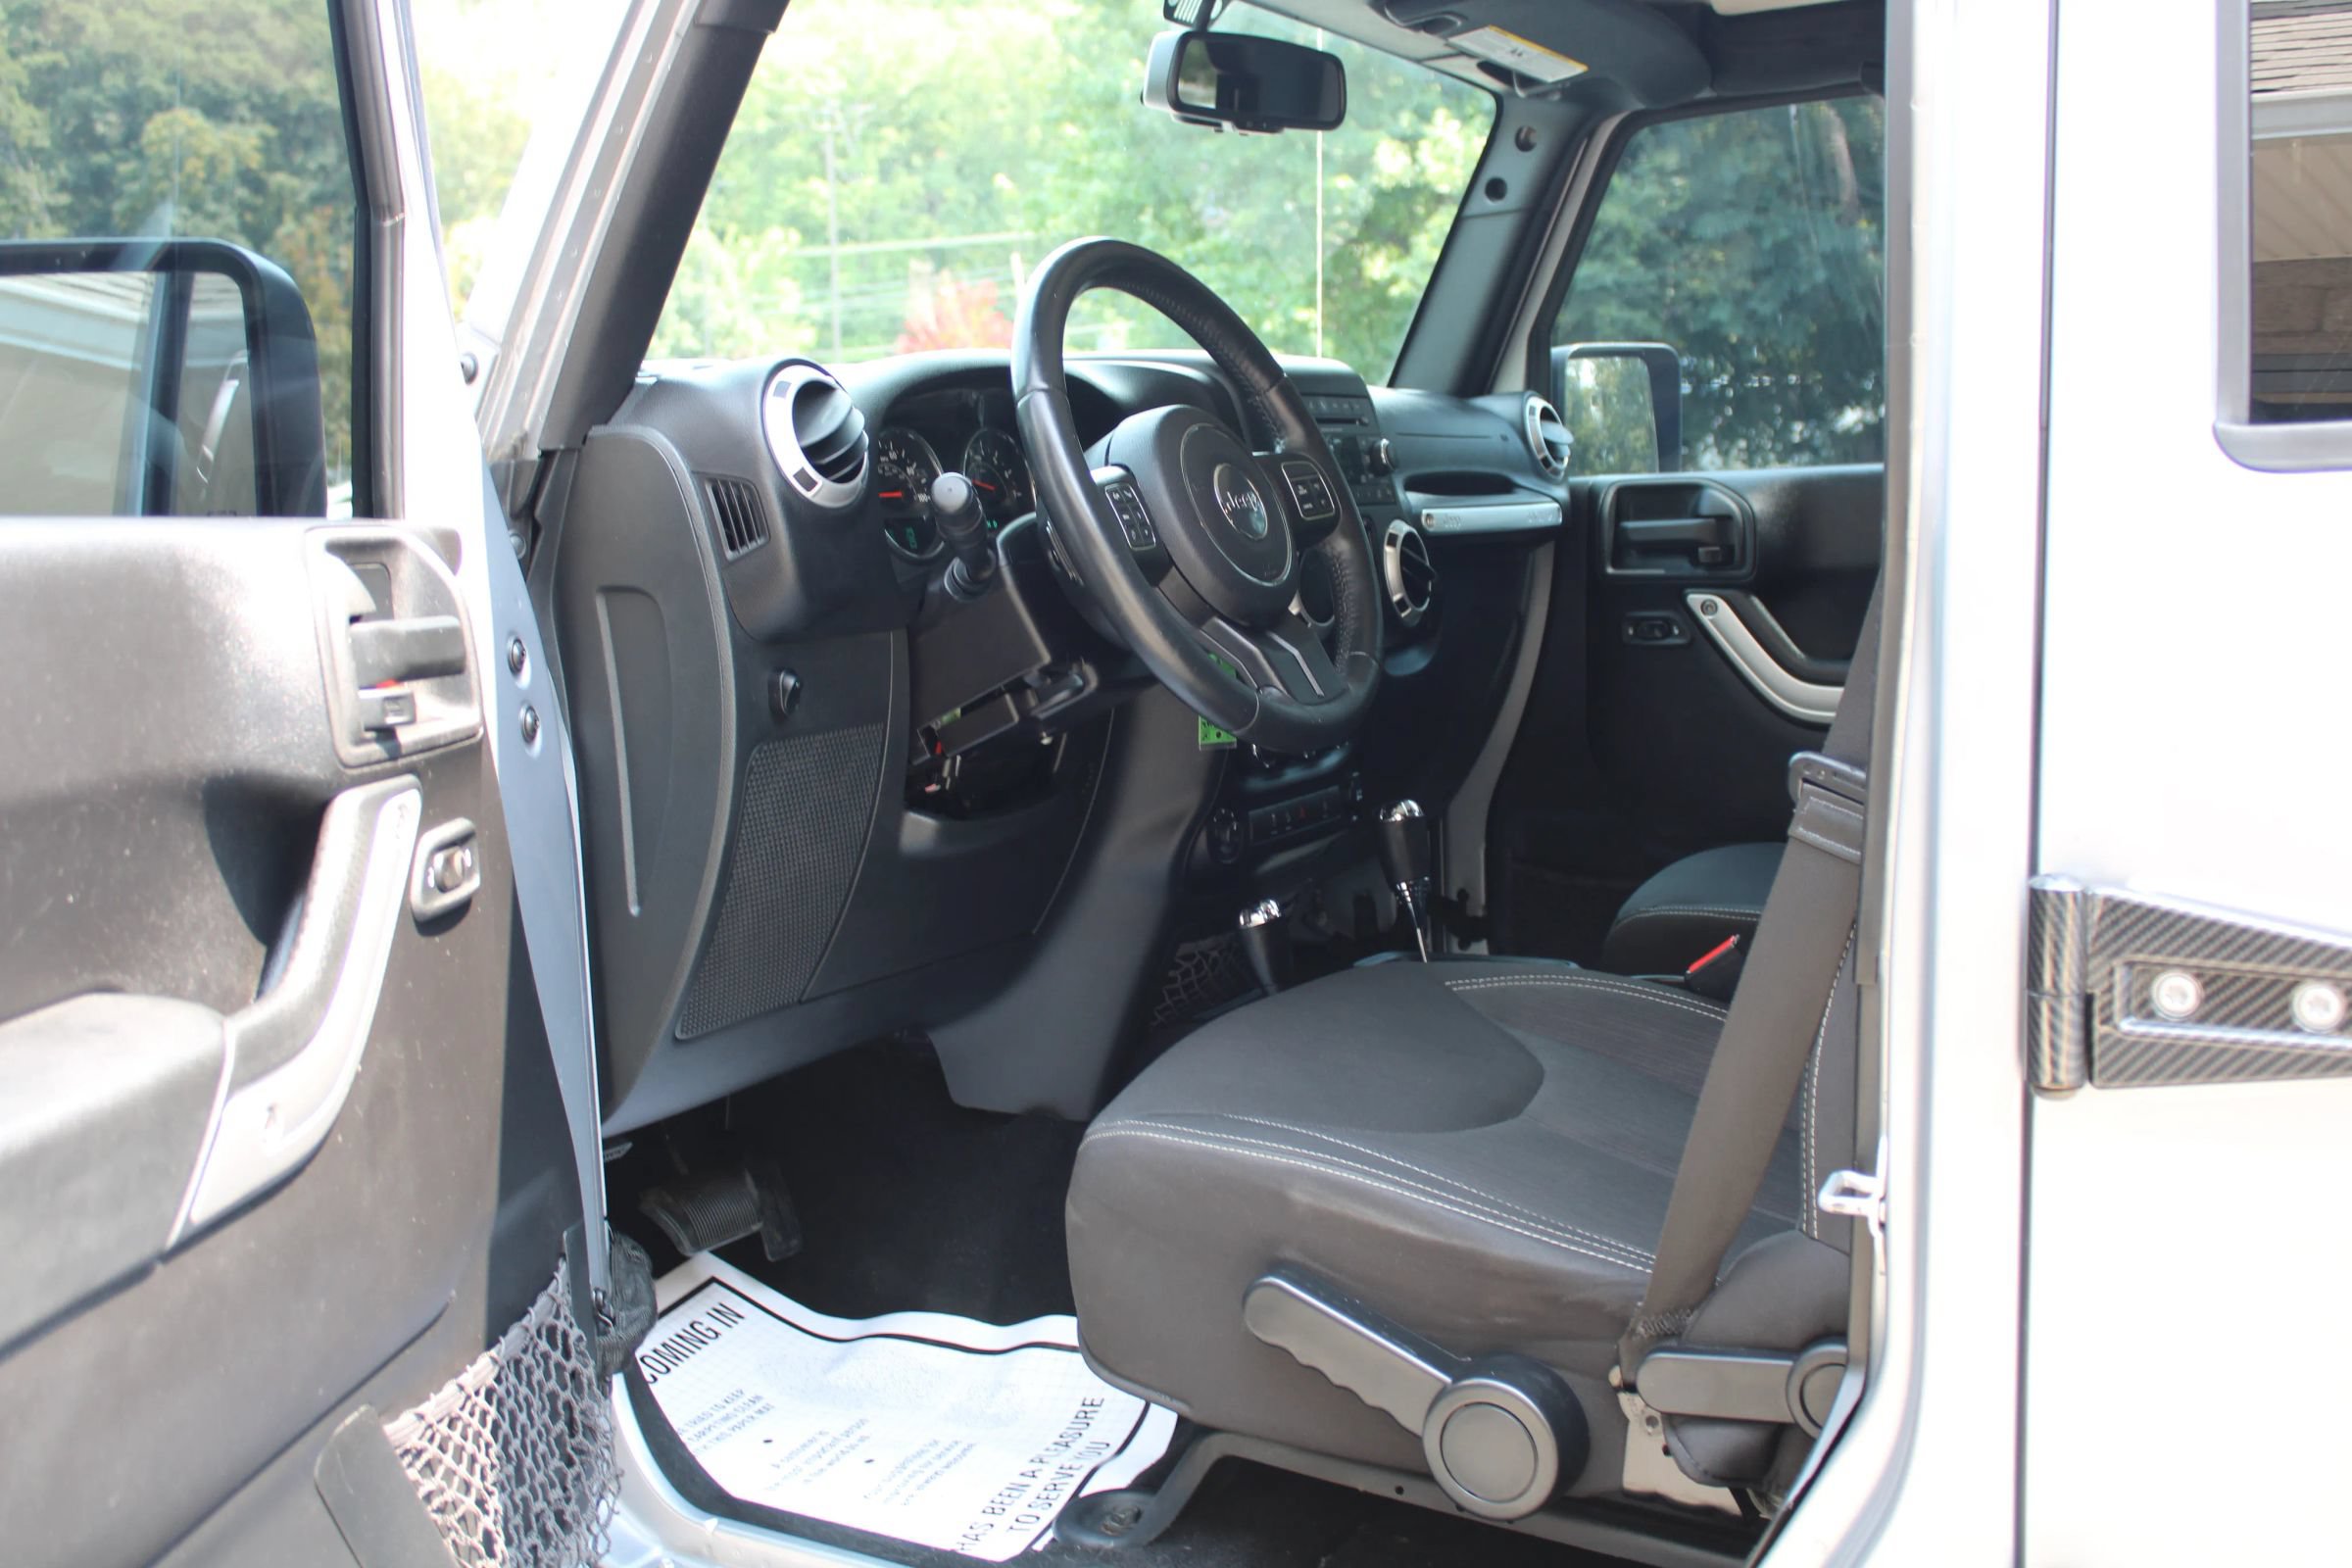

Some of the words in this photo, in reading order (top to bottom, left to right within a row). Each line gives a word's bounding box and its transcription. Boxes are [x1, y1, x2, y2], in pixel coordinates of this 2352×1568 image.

[705, 1301, 746, 1329] IN
[1029, 1396, 1105, 1465] PLEASURE
[1005, 1513, 1042, 1534] TO
[1027, 1464, 1084, 1510] SERVE
[1069, 1440, 1111, 1462] YOU
[1018, 1467, 1044, 1480] A
[981, 1481, 1032, 1516] BEEN
[956, 1521, 995, 1551] HAS
